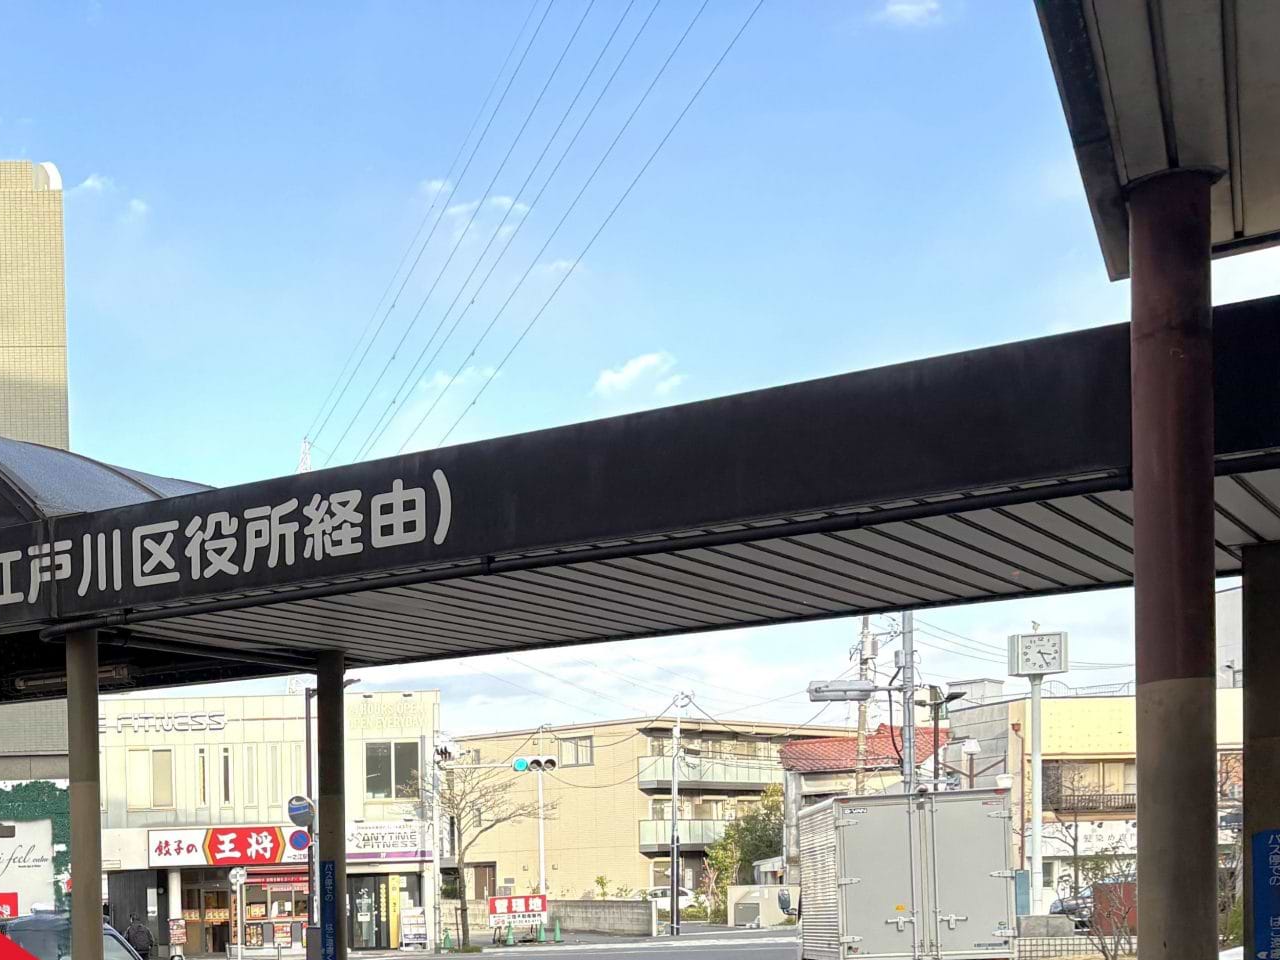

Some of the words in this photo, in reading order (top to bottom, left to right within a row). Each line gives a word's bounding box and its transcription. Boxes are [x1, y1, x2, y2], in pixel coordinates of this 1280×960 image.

[117, 711, 226, 733] FITNESS
[362, 832, 417, 842] ANYTIME
[363, 840, 417, 849] FITNESS
[155, 840, 198, 857] 餃子の
[214, 832, 274, 860] 王将
